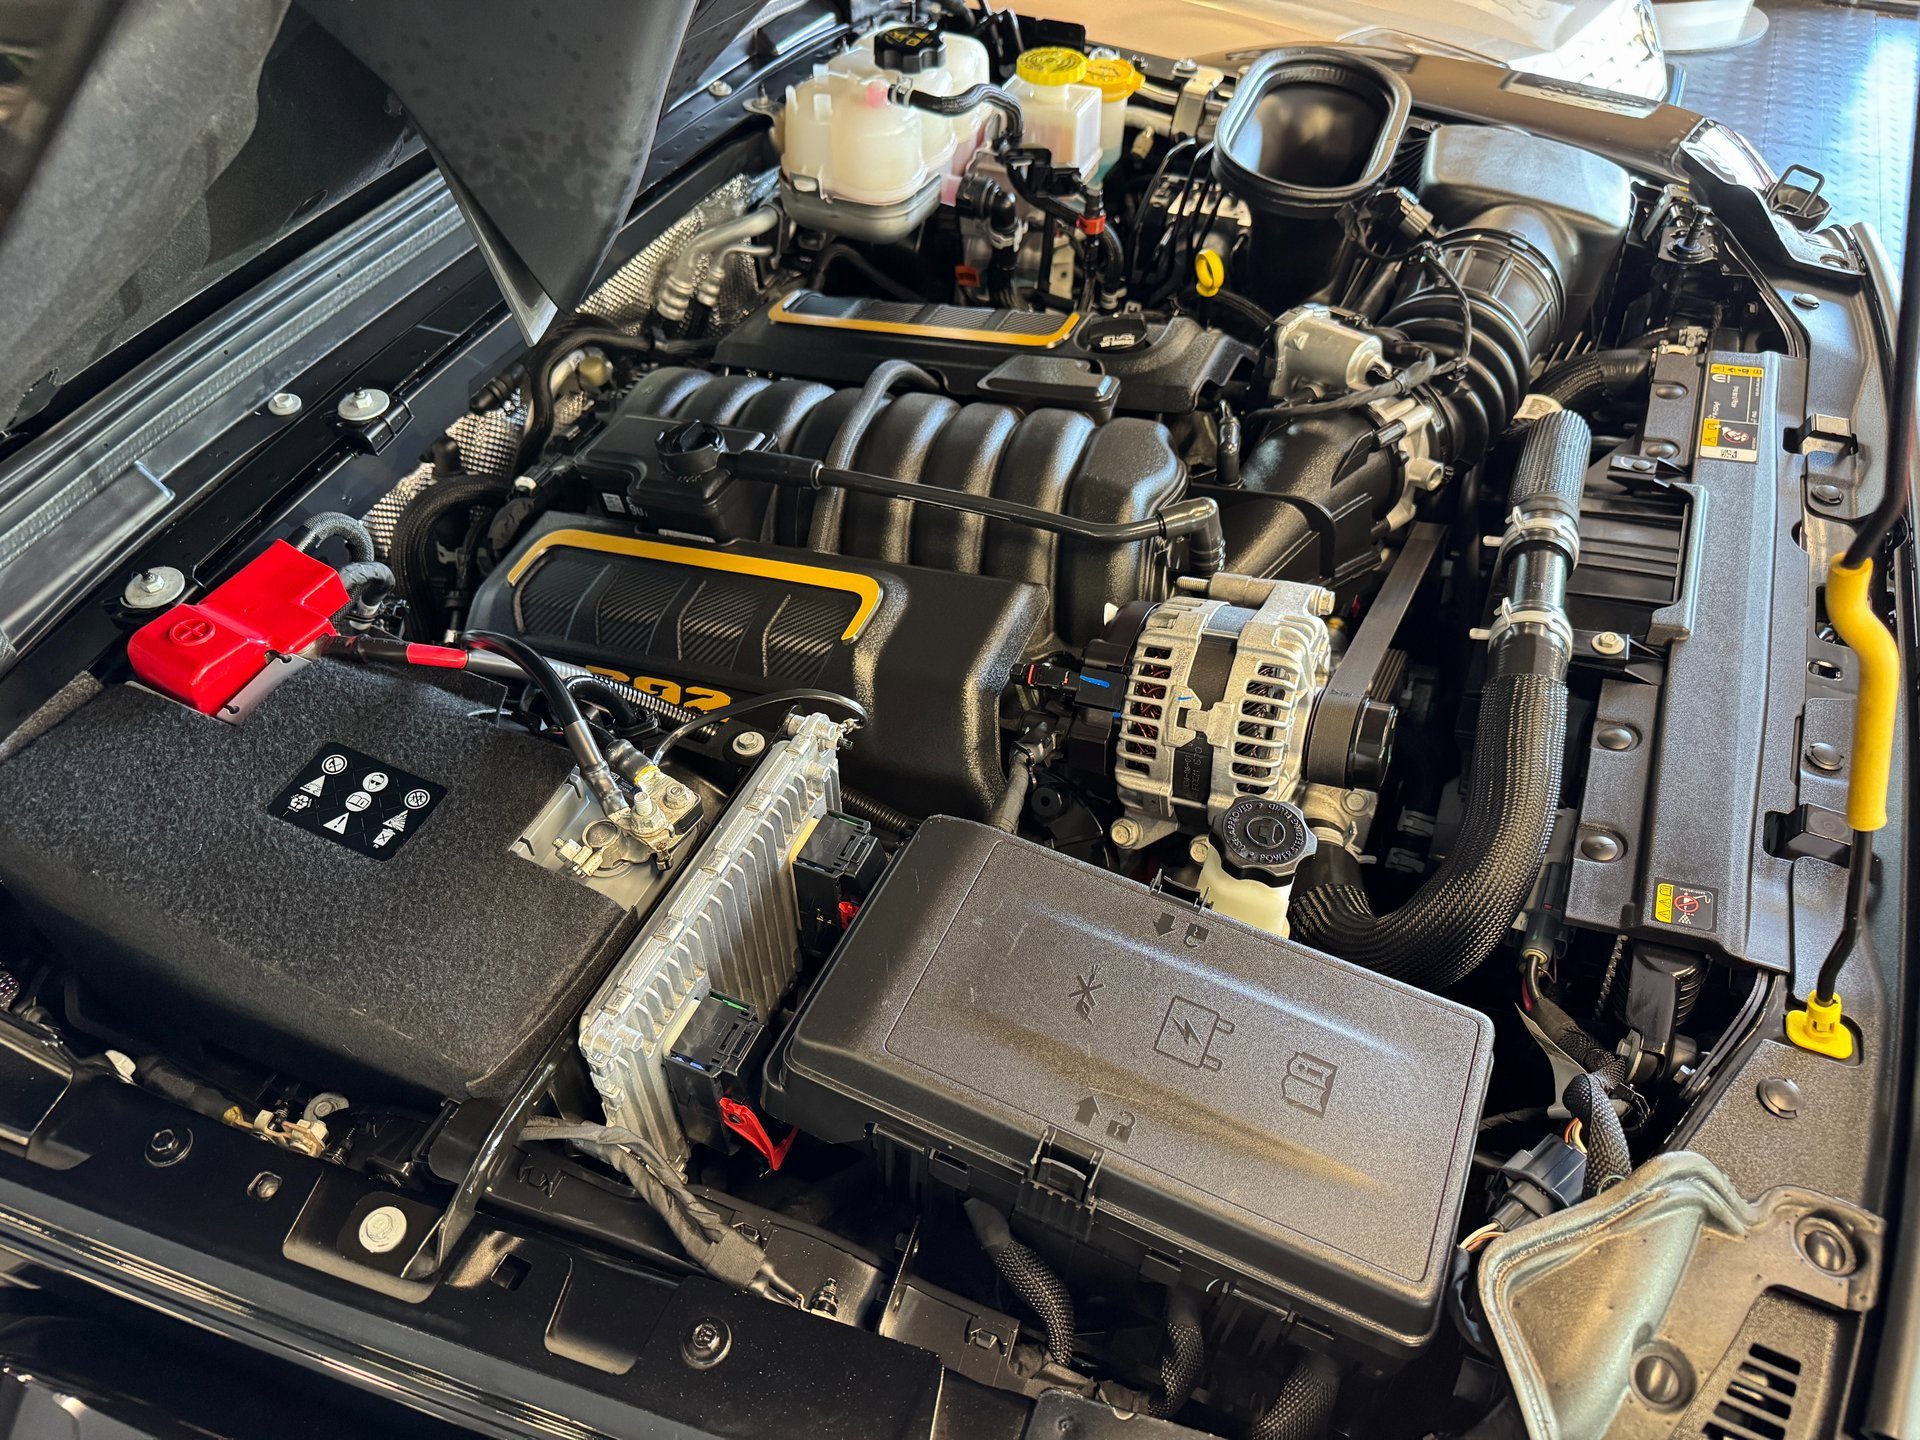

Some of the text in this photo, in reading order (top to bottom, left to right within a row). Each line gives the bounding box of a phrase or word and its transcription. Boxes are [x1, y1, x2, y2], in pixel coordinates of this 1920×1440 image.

[1227, 802, 1253, 851] USE APPROVED
[1259, 803, 1304, 863] POWER STEERING FLUID
